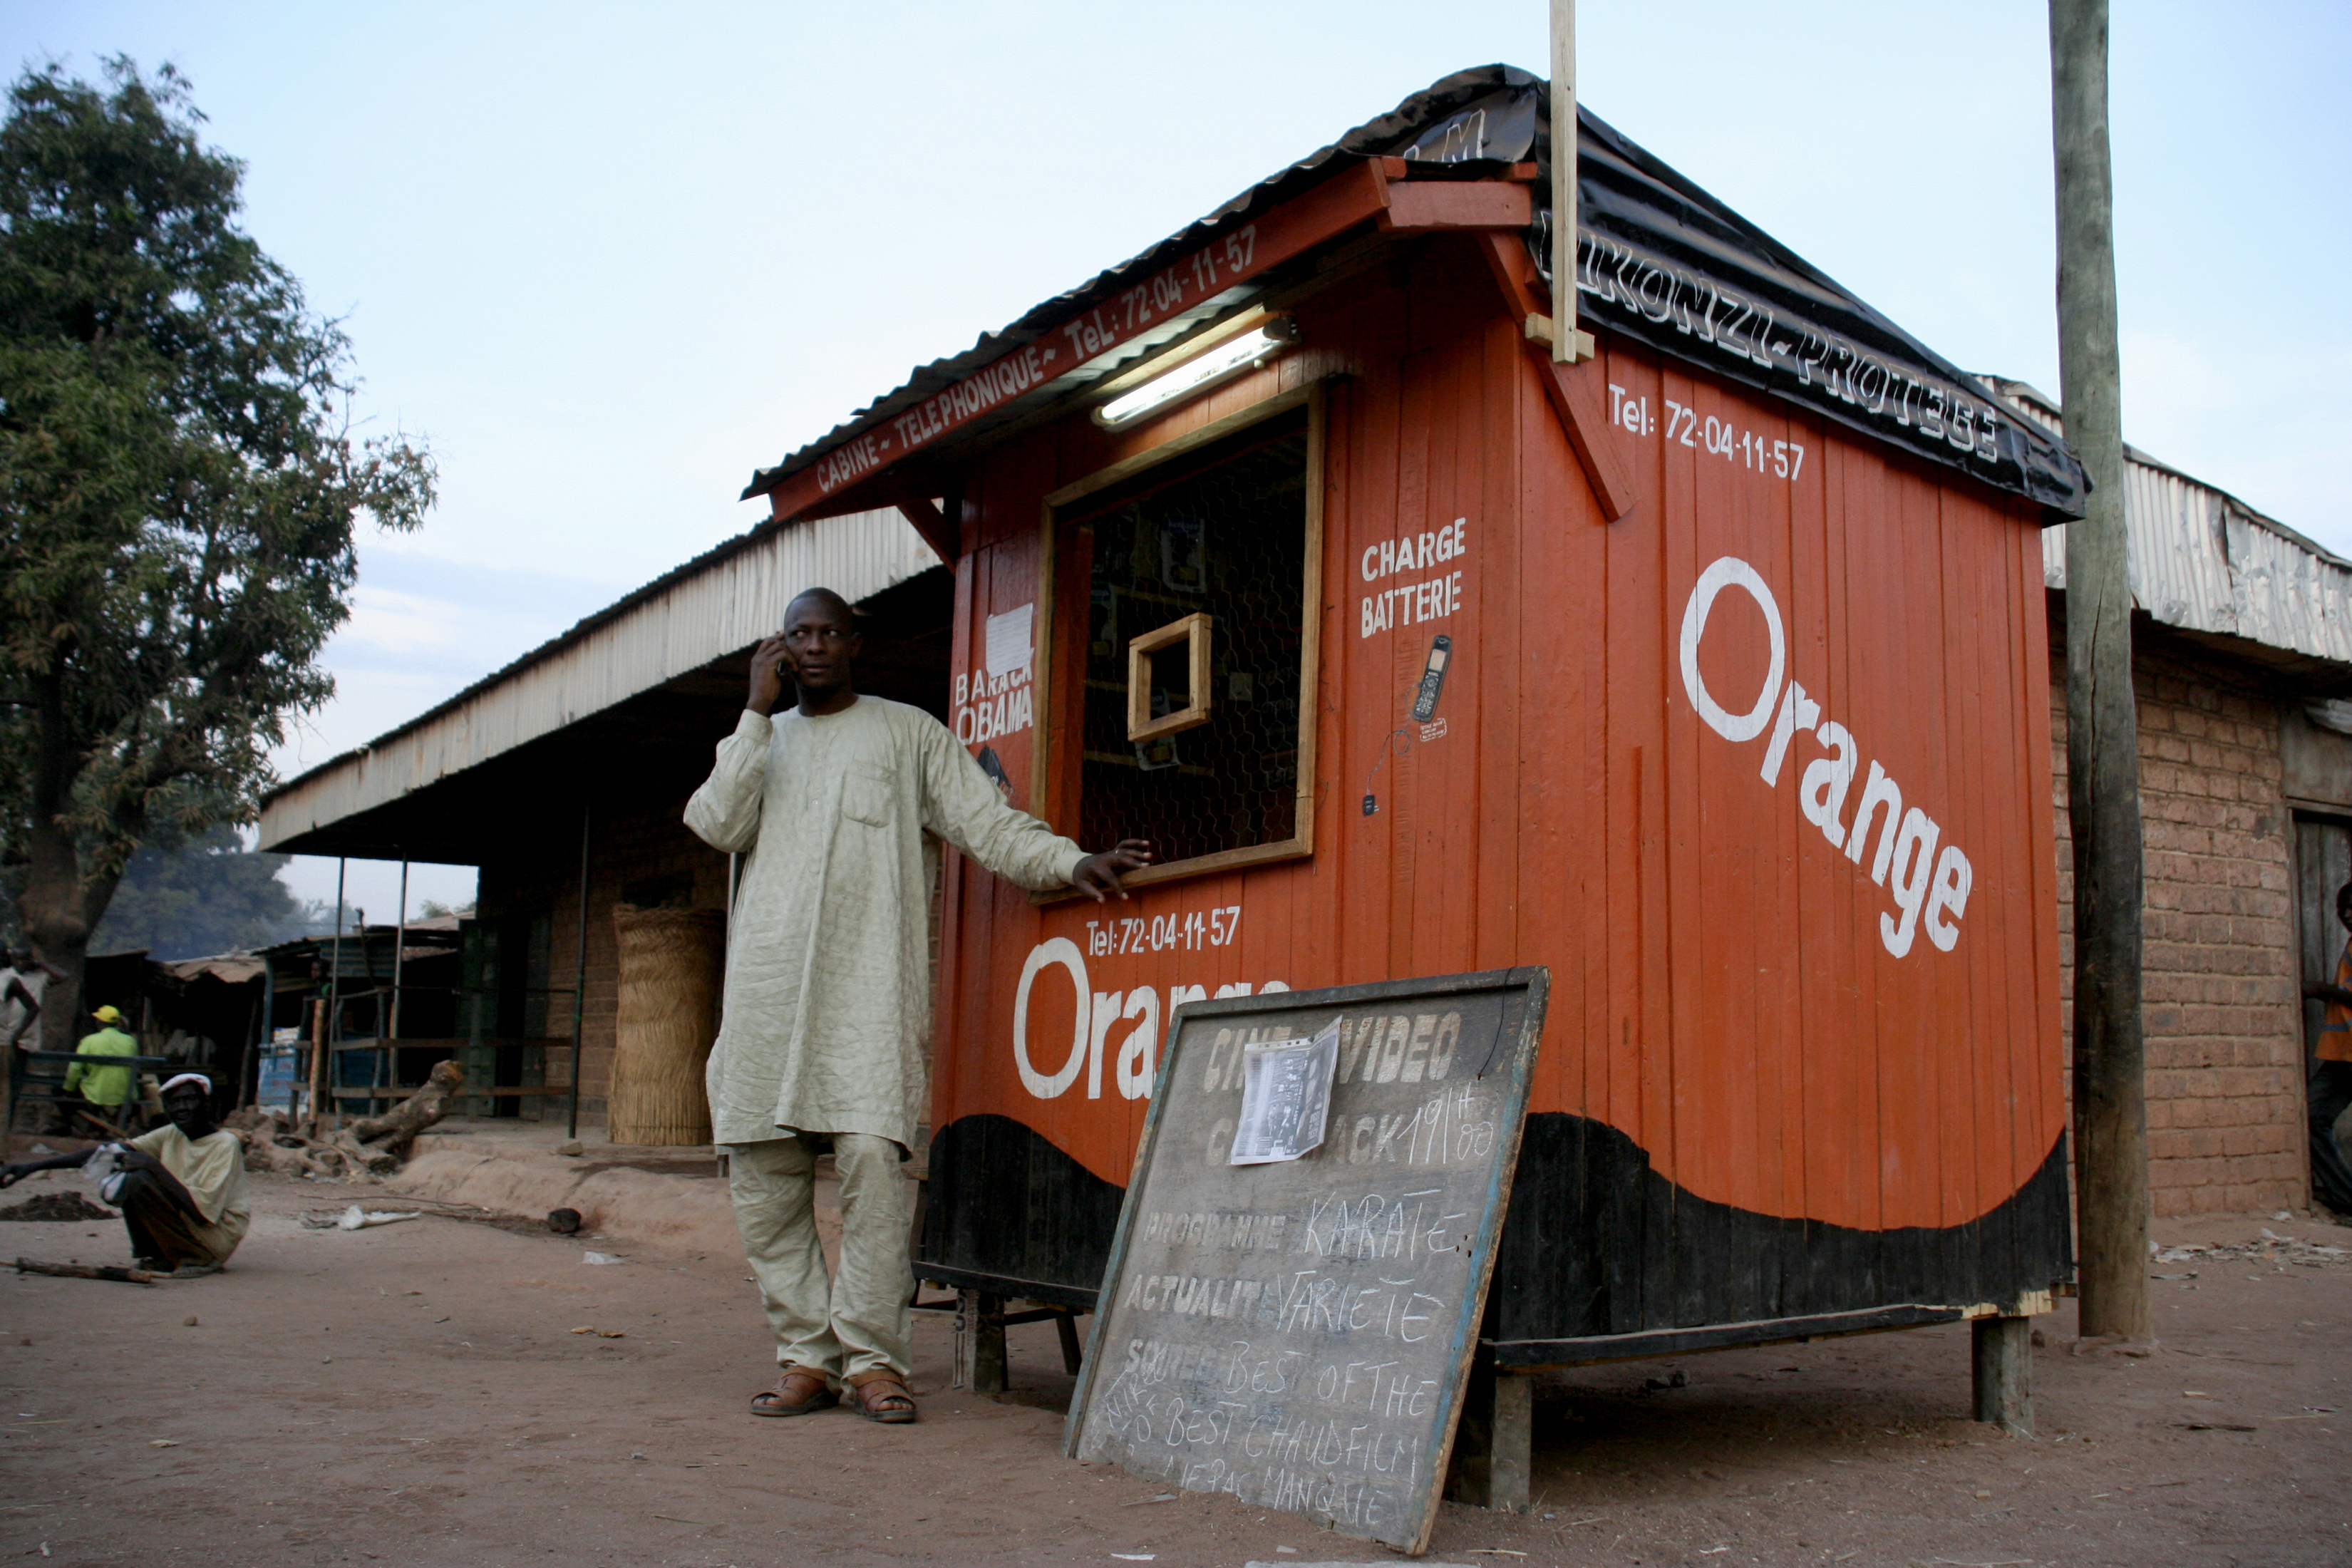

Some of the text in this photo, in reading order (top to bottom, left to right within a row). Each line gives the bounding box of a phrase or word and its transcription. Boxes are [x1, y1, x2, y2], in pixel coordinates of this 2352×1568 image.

[1608, 383, 1654, 435] Tel:
[1361, 517, 1466, 582] CHARGE
[1361, 570, 1462, 639] BATTERIE
[956, 685, 1033, 747] OBAMA
[1679, 556, 1973, 959] Orange
[1339, 1011, 1461, 1084] VIDEO
[1305, 1190, 1466, 1262] KARATE
[1223, 1341, 1310, 1394] BEST
[1319, 1360, 1368, 1403] OF
[1363, 1361, 1437, 1417] THE
[1165, 1397, 1247, 1447] BEST
